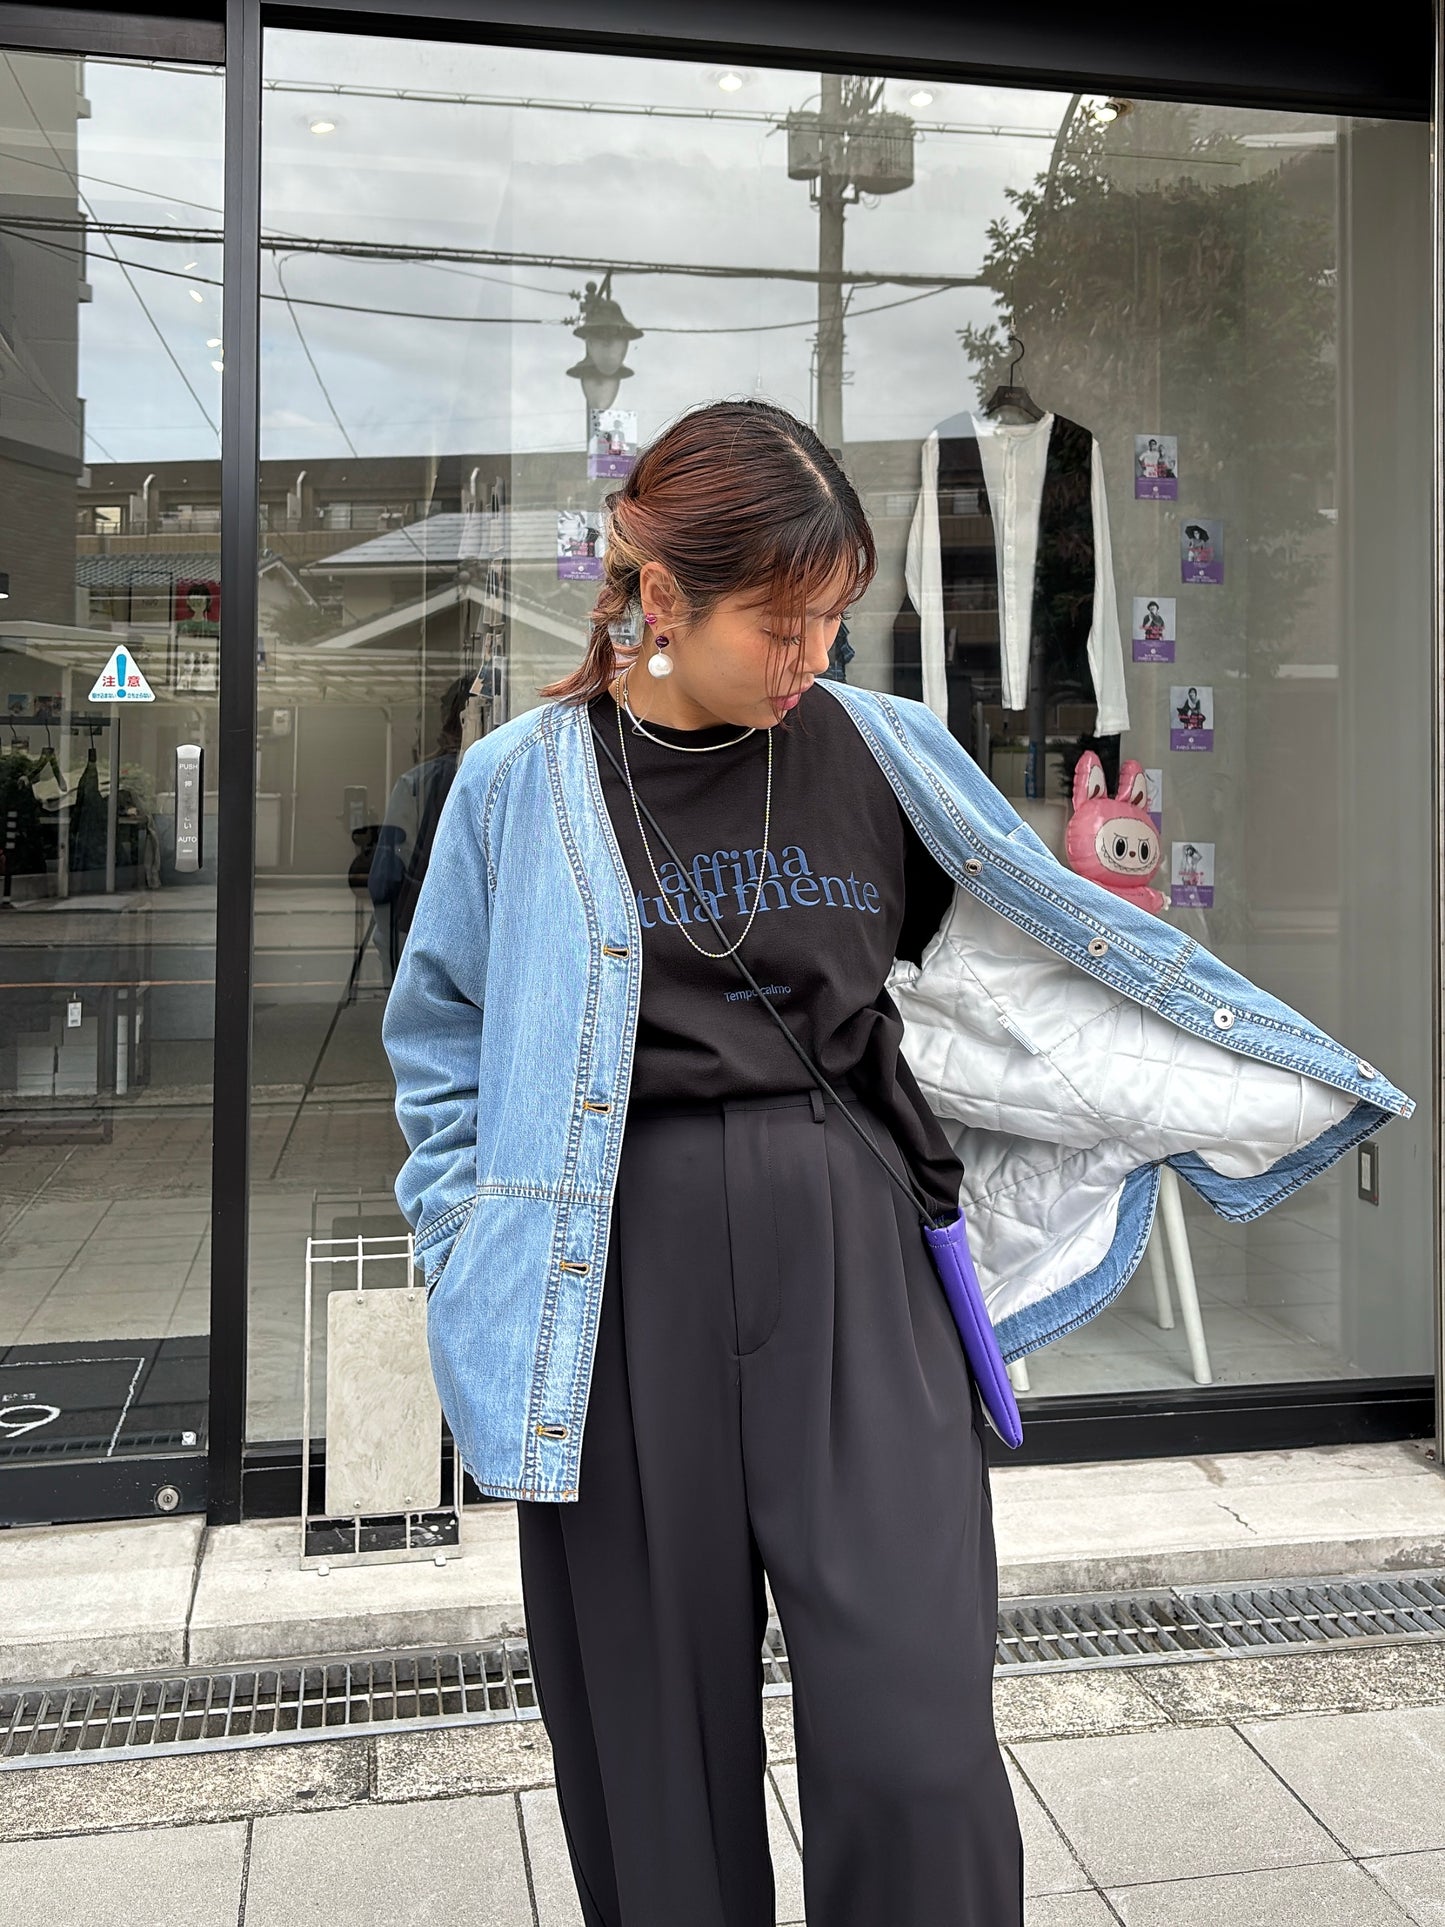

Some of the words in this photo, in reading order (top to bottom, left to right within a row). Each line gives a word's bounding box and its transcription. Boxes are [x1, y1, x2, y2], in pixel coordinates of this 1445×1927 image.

[659, 845, 813, 898] affina
[732, 871, 881, 916] mente
[636, 889, 723, 928] tua
